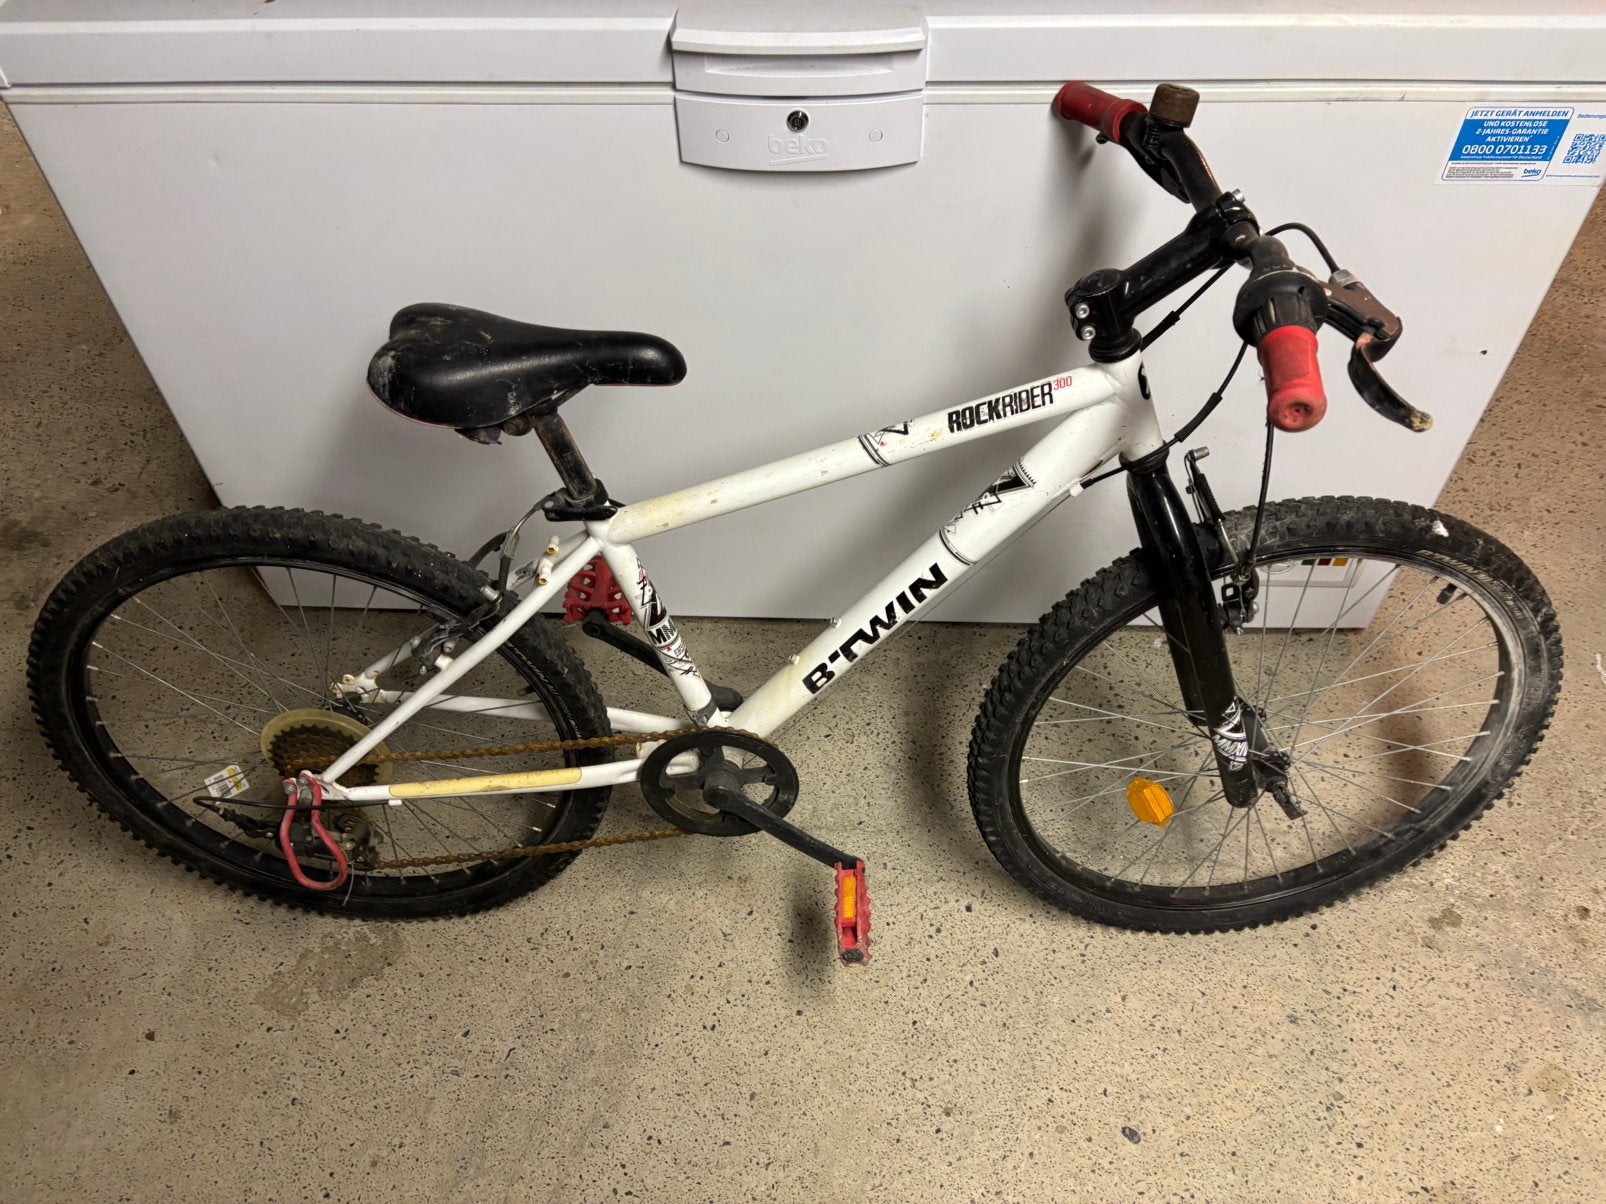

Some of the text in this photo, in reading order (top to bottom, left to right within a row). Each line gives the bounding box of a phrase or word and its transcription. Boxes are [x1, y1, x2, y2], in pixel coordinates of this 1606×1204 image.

[1471, 110, 1496, 118] JETZT
[1495, 109, 1524, 117] GERÄT
[768, 133, 829, 155] beko
[1462, 144, 1548, 154] 0800 0701133
[1522, 168, 1542, 176] beko
[947, 376, 1073, 433] ROCKRIDER 300
